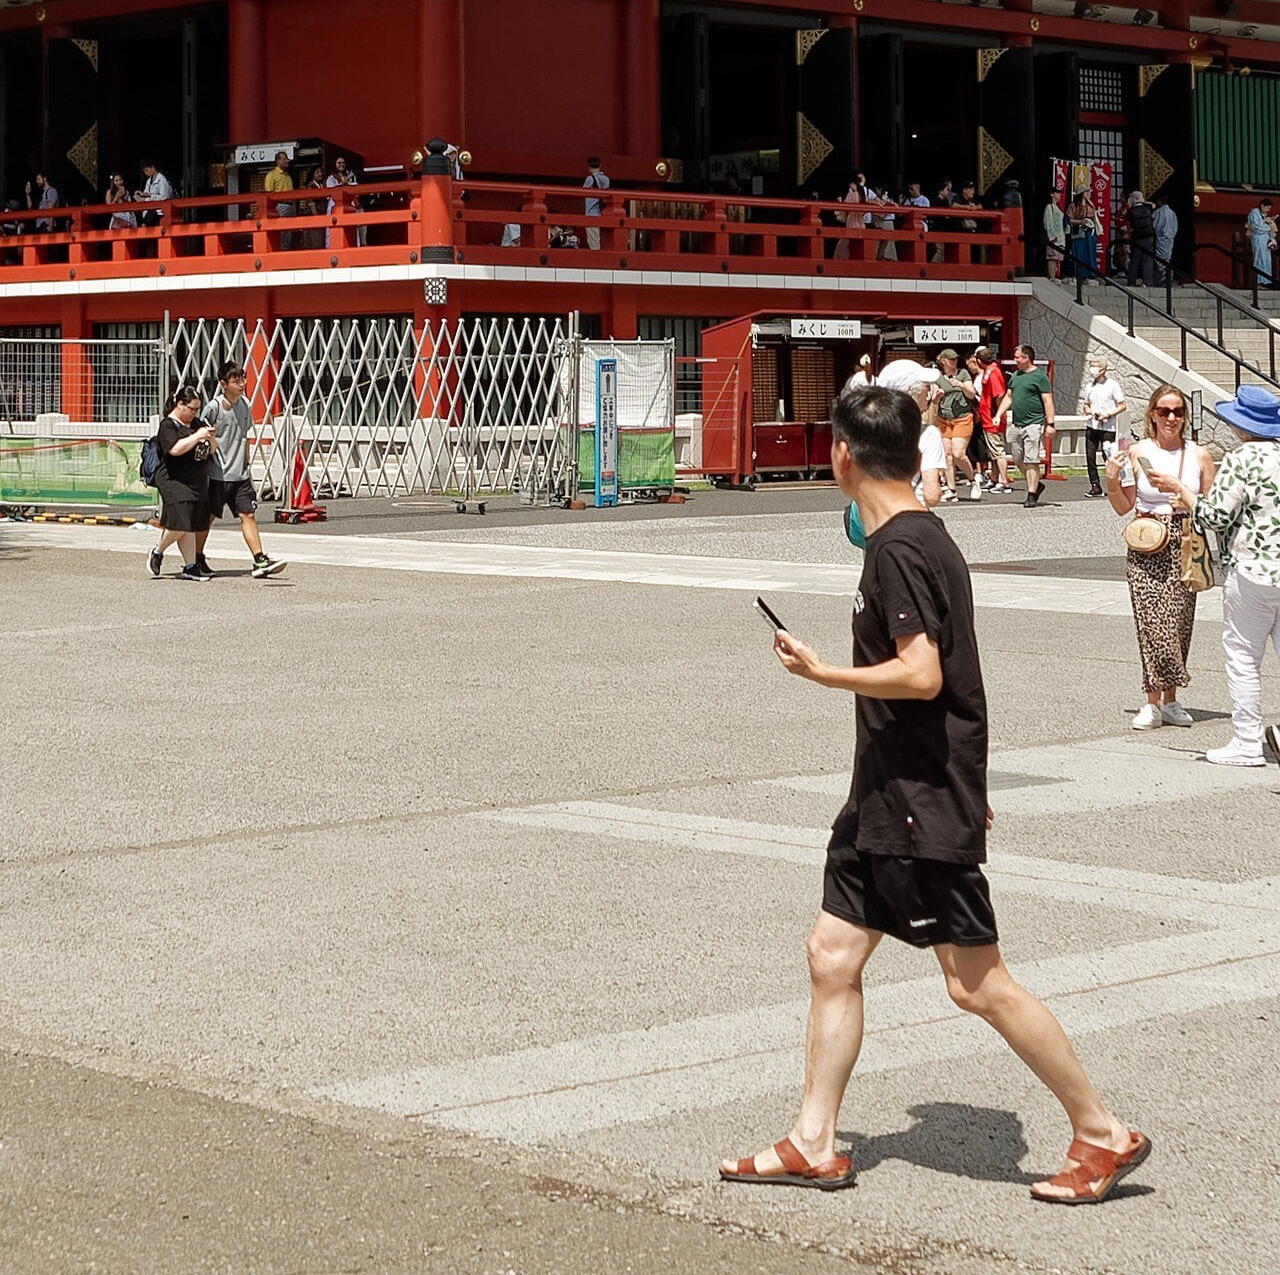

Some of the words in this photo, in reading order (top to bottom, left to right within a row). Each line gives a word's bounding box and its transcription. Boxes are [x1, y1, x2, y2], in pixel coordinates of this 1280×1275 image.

[241, 151, 266, 161] みくじ
[798, 323, 828, 336] みくじ
[837, 328, 855, 336] 100円
[921, 329, 949, 341] みくじ
